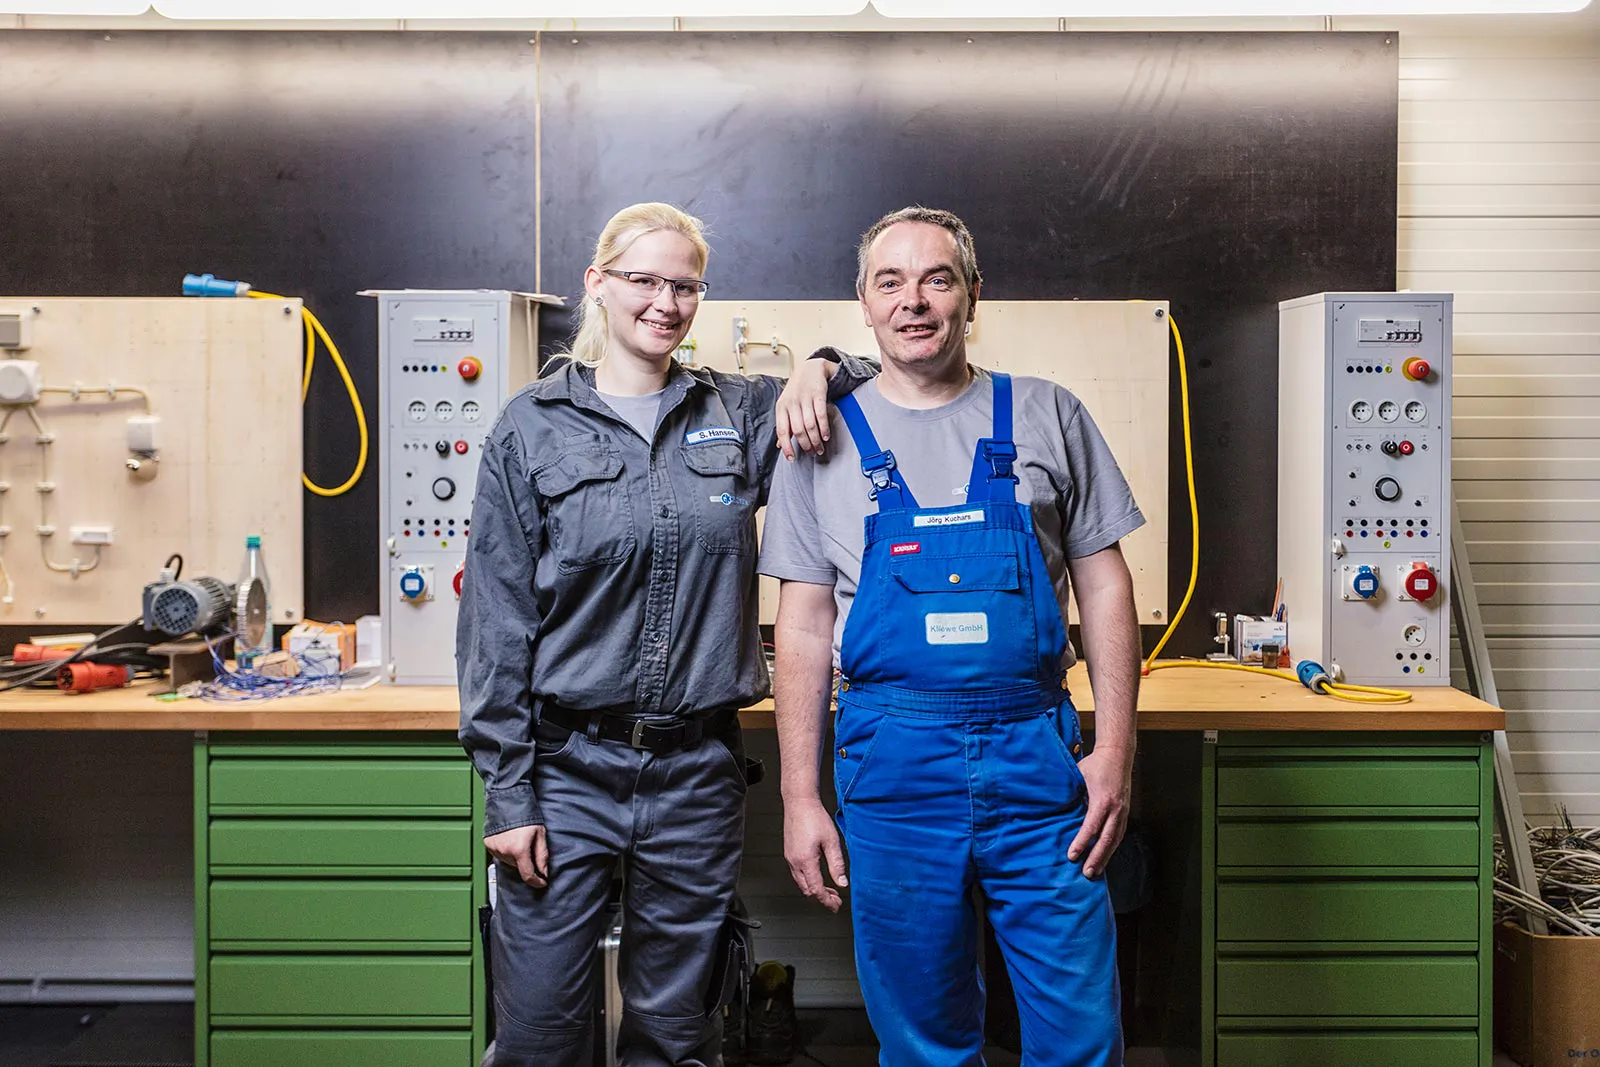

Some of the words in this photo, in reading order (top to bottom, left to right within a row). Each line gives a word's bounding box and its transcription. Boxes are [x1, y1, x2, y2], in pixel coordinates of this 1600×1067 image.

[699, 431, 708, 439] S.
[927, 516, 943, 524] Jörg
[958, 624, 983, 632] GmbH
